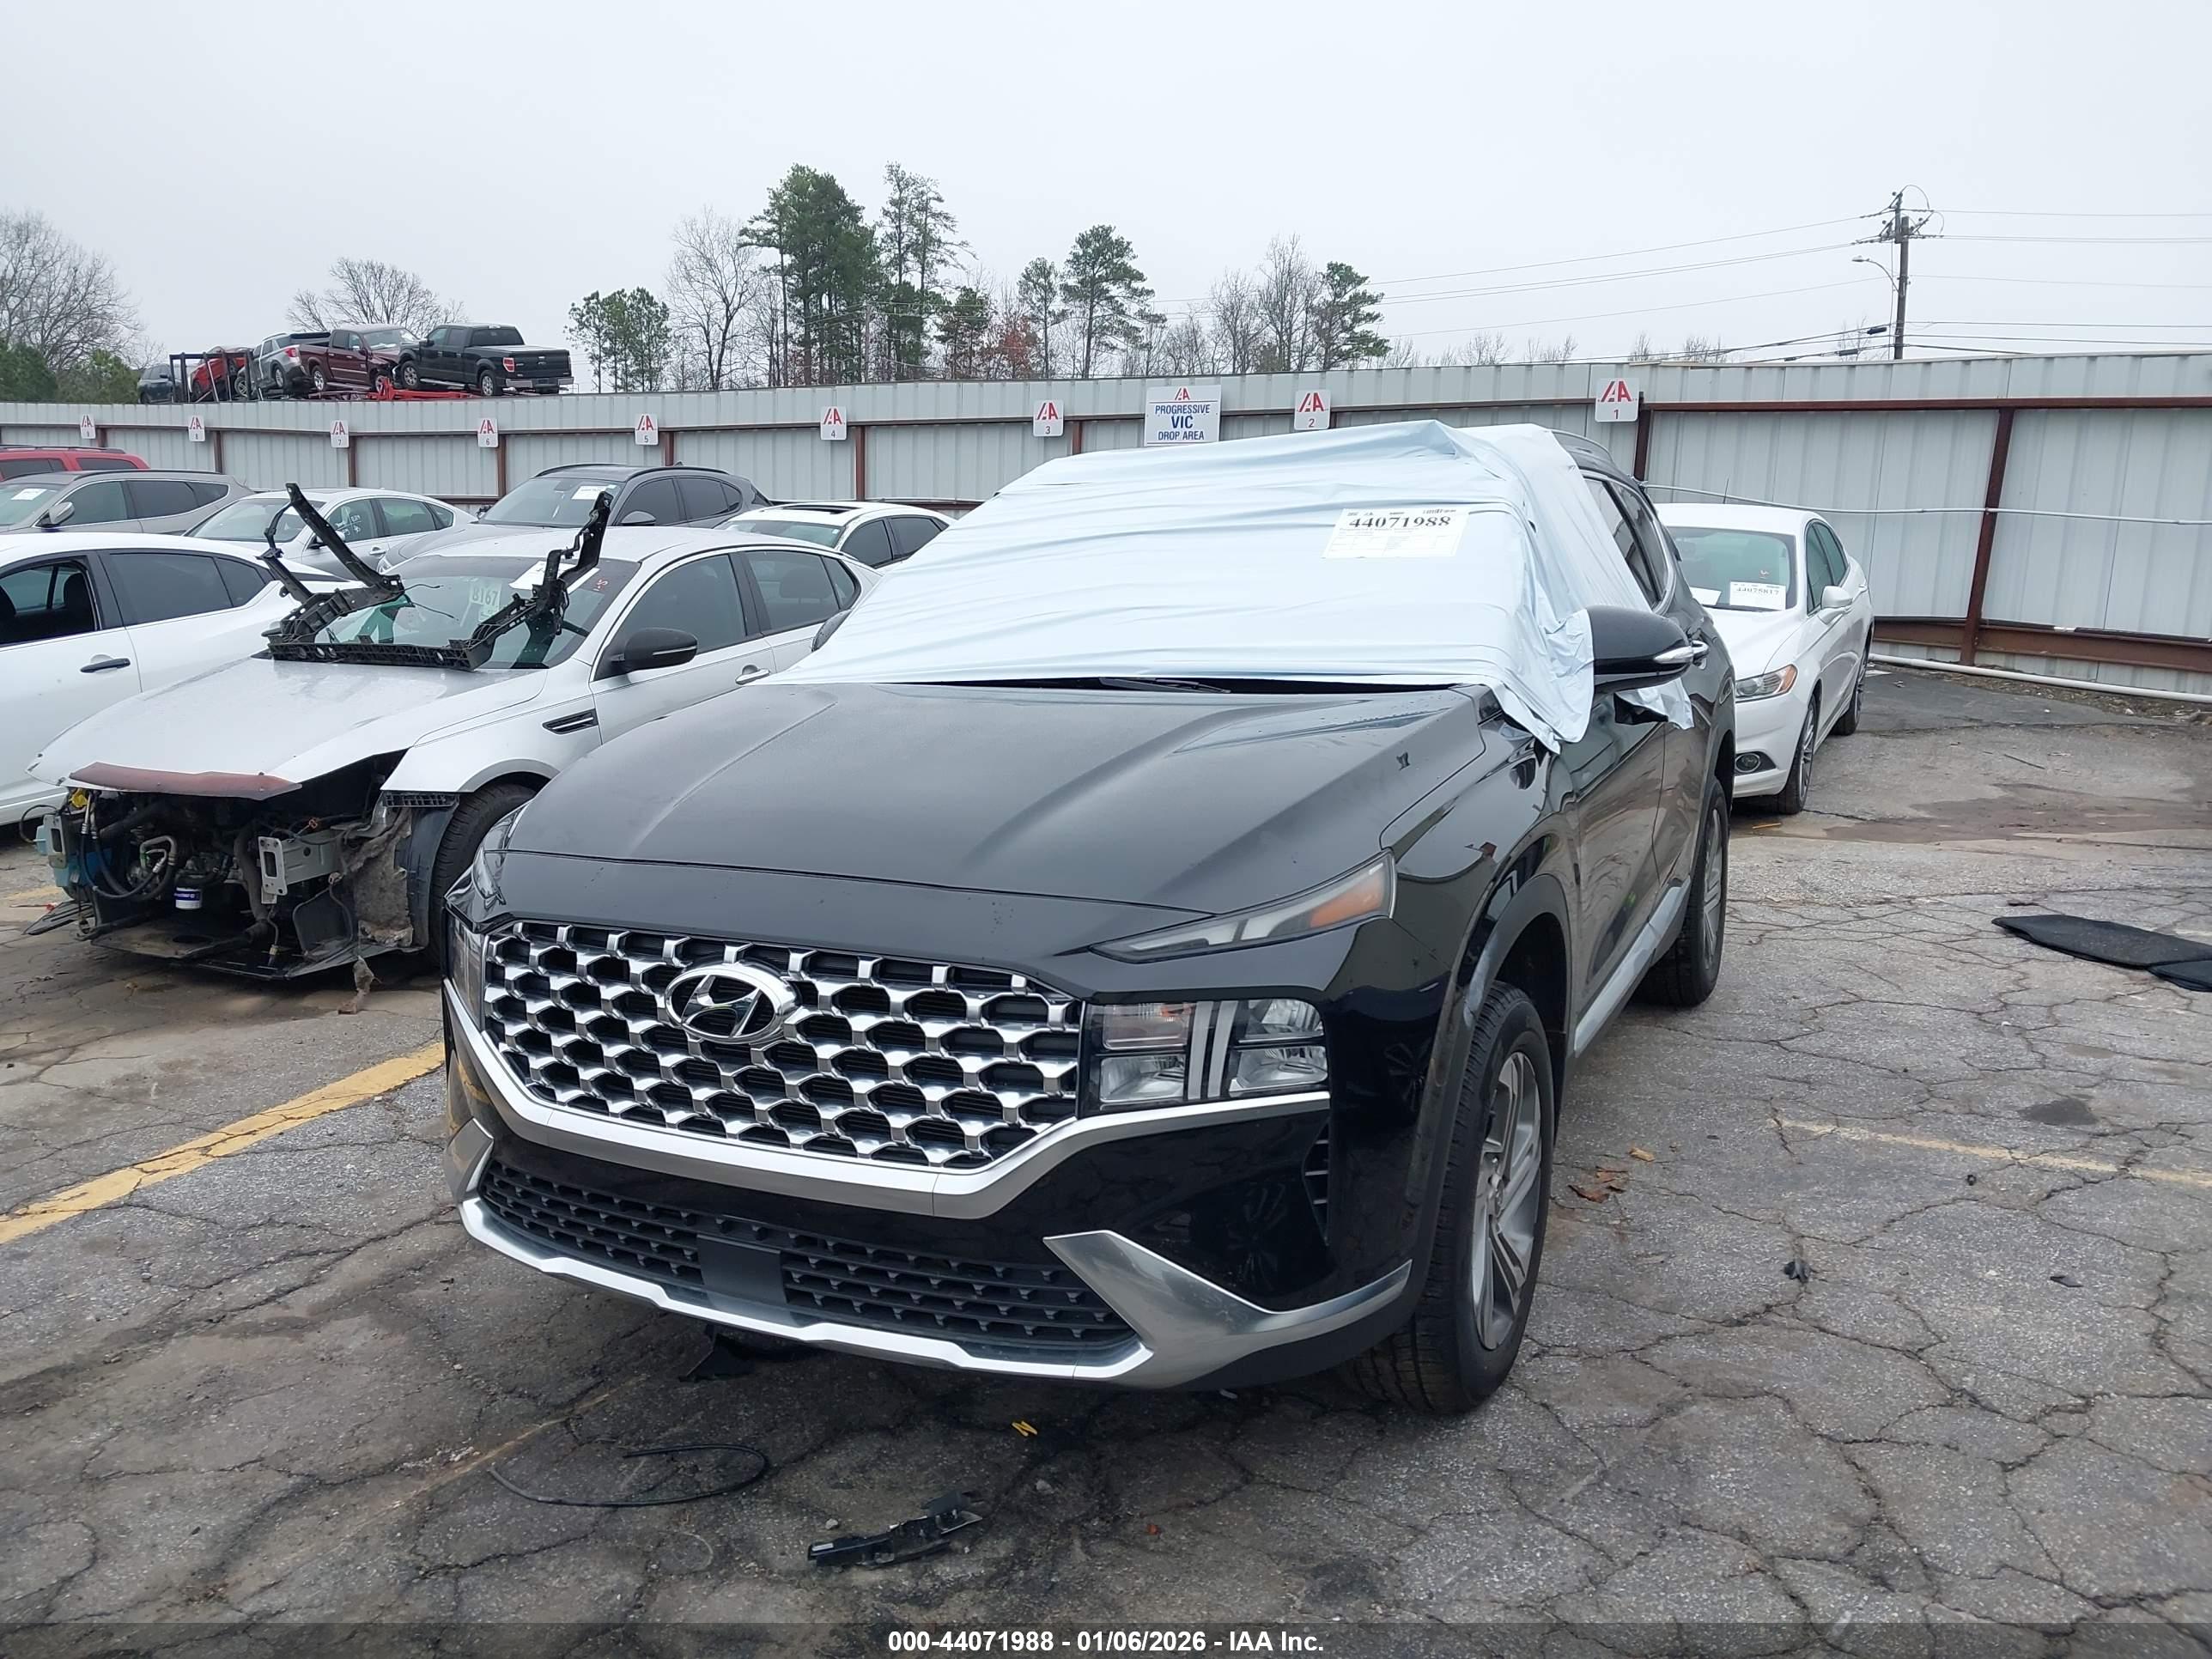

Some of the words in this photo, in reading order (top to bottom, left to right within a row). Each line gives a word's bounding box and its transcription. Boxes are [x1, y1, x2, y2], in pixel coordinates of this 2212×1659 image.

[1155, 404, 1211, 415] PROGRESSIVE
[1613, 409, 1619, 420] 1
[1170, 415, 1194, 429] VIC
[1308, 418, 1315, 428] 2
[1044, 426, 1051, 434] 3
[1158, 431, 1181, 441] DROP
[1182, 430, 1205, 441] AREA
[643, 434, 649, 443] 5
[1348, 516, 1452, 529] 44071988
